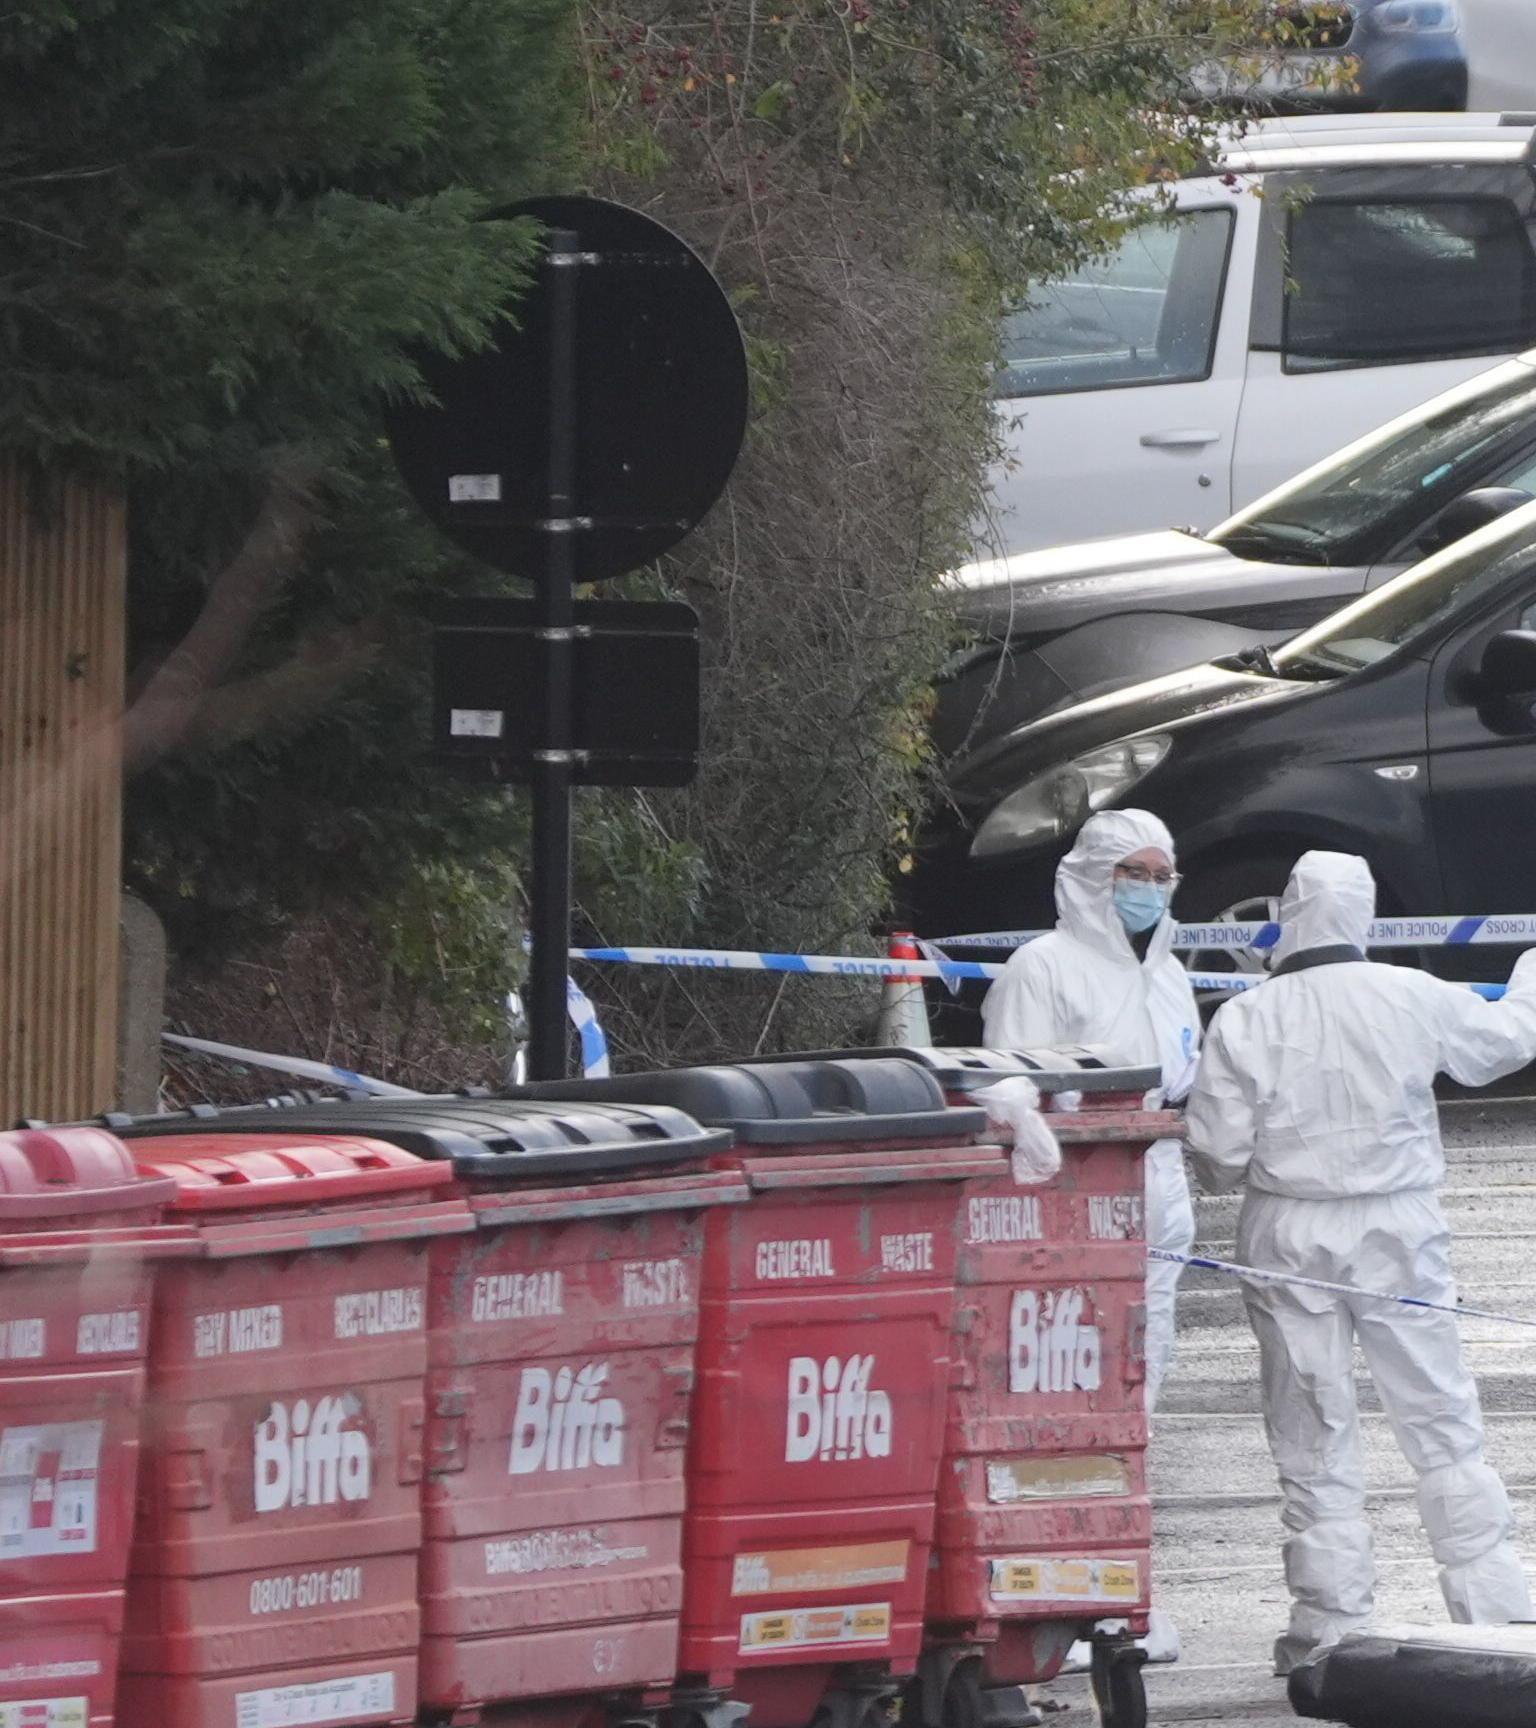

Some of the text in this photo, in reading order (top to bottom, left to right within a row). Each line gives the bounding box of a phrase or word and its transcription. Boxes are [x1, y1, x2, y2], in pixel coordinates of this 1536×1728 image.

[1181, 929, 1209, 945] LINE
[1210, 927, 1251, 945] POLICE
[1407, 921, 1448, 938] POLICE
[1485, 919, 1526, 935] CROSS
[967, 1195, 1043, 1242] GENERAL
[755, 1231, 934, 1280] GENERAL WASTE
[471, 1270, 564, 1323] GENERAL
[1010, 1287, 1101, 1394] Biffa
[508, 1359, 625, 1475] Biffa
[784, 1352, 893, 1463] Biffa
[254, 1394, 371, 1513] Biffa
